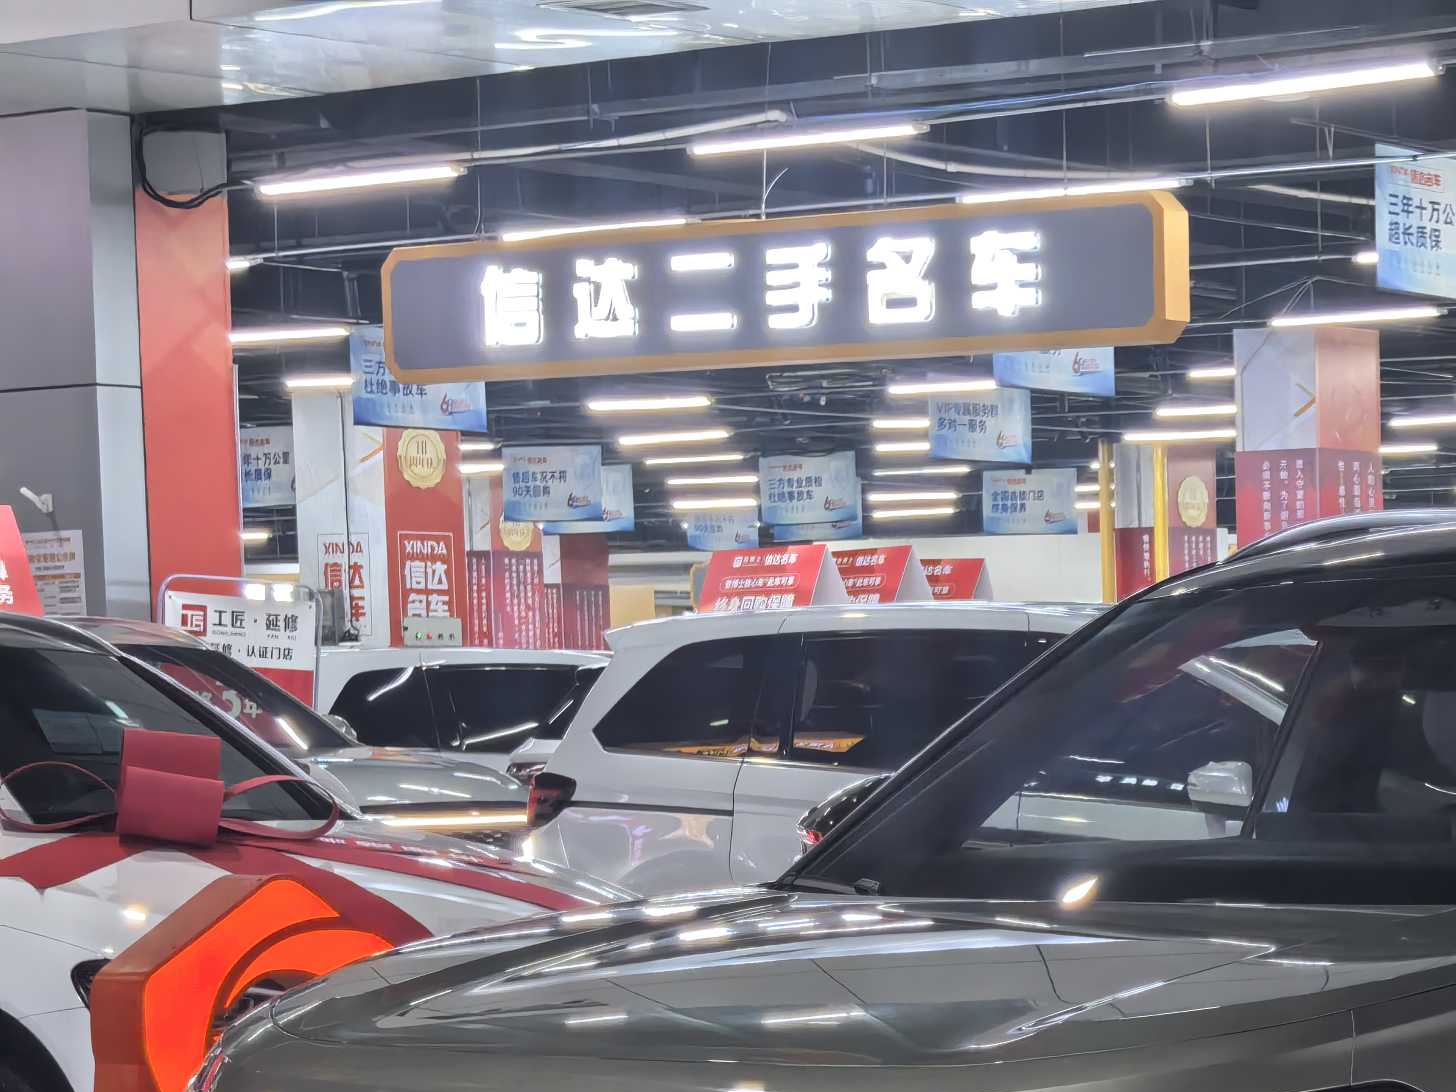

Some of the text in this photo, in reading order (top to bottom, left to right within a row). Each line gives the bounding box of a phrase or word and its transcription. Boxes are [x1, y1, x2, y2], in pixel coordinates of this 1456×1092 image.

[1388, 221, 1442, 251] 超长质保
[480, 230, 1042, 347] 信达二手名车
[404, 540, 448, 555] XINDA
[405, 561, 449, 590] 信达
